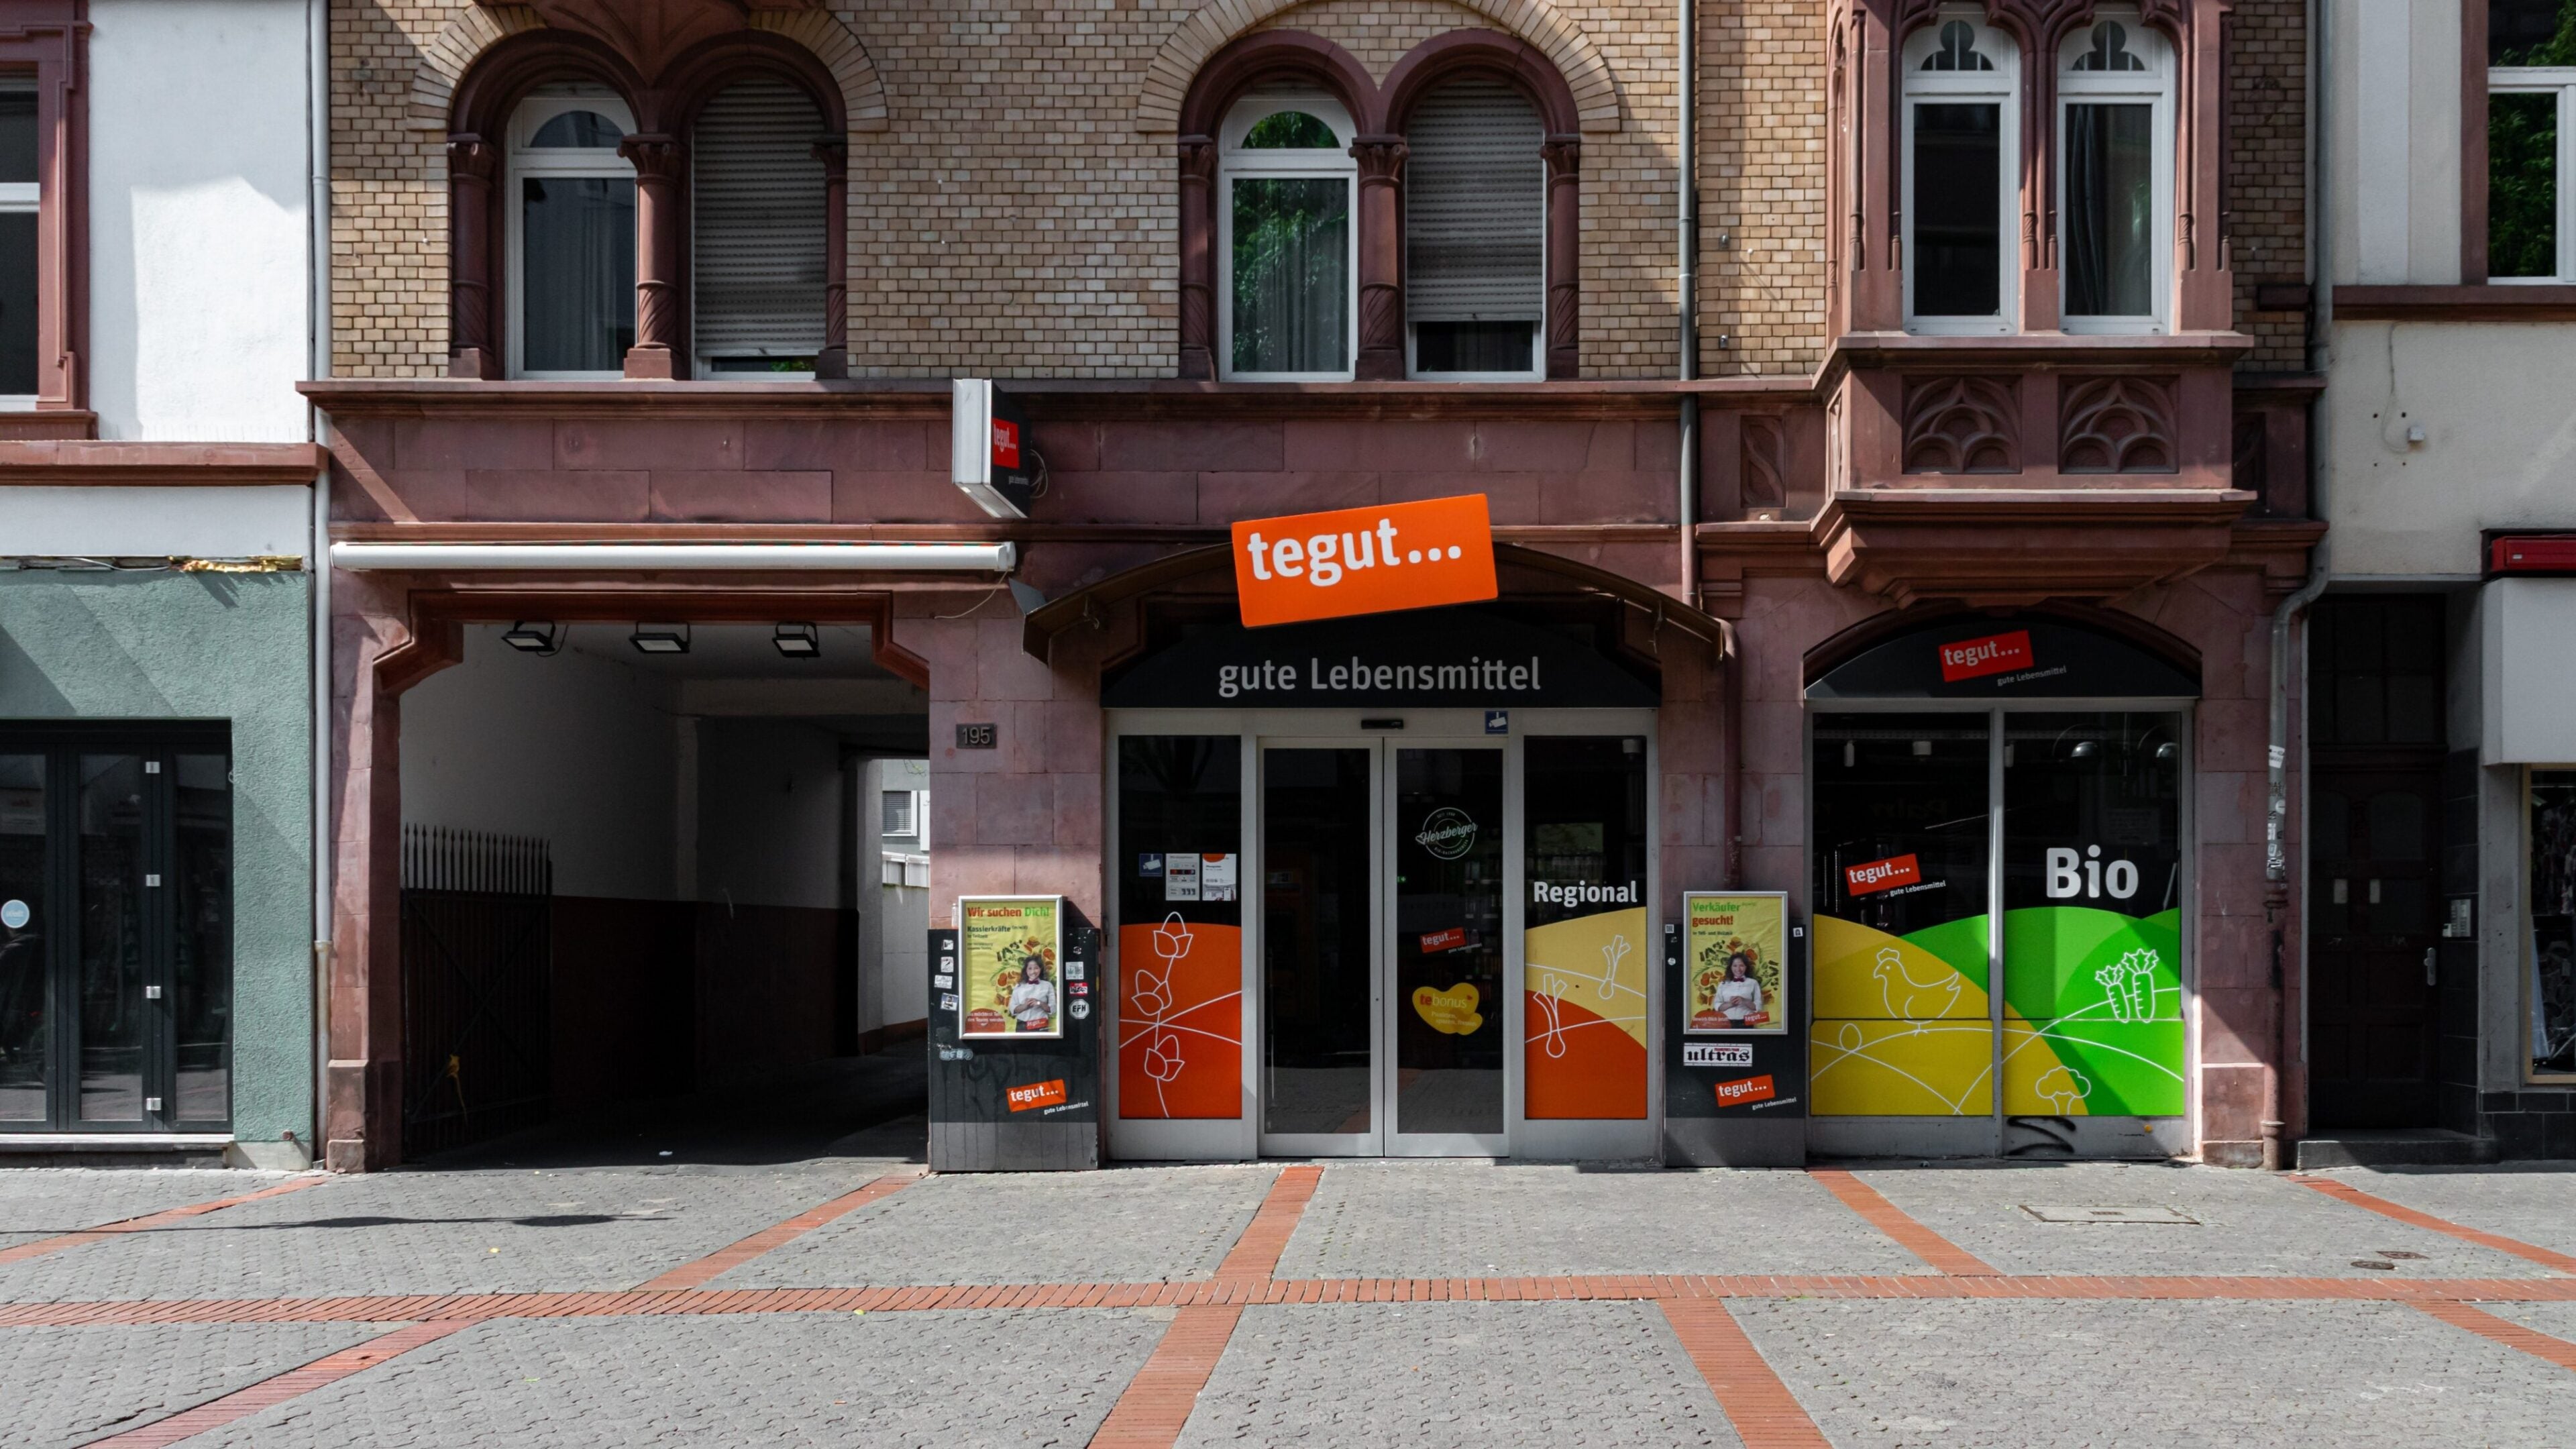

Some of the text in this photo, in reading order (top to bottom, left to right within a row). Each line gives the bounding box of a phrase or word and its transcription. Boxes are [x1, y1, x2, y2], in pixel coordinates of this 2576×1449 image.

[993, 423, 1016, 453] tegut...
[1246, 518, 1462, 587] tegut...
[1944, 641, 2020, 667] tegut...
[1218, 656, 1541, 698] gute Lebensmittel
[1997, 665, 2067, 686] gute Lebensmittel
[962, 727, 990, 745] 195
[1415, 822, 1479, 845] Herzberger
[1849, 862, 1911, 883] tegut...
[2046, 844, 2139, 899] Bio
[1534, 880, 1638, 908] Regional
[1890, 880, 1946, 898] gute Lebensmittel
[967, 907, 1049, 917] Wir suchen Dich!
[1693, 902, 1741, 912] Verkäufer
[1692, 915, 1733, 928] gesucht!
[1422, 932, 1460, 946] tegut...
[1419, 993, 1468, 1008] tebonus
[1745, 1014, 1767, 1022] tegut...
[1686, 1047, 1750, 1061] ultras
[1010, 1085, 1059, 1102] tegut...
[1719, 1081, 1767, 1097] tegut...
[1764, 1097, 1797, 1107] Lebensmittel
